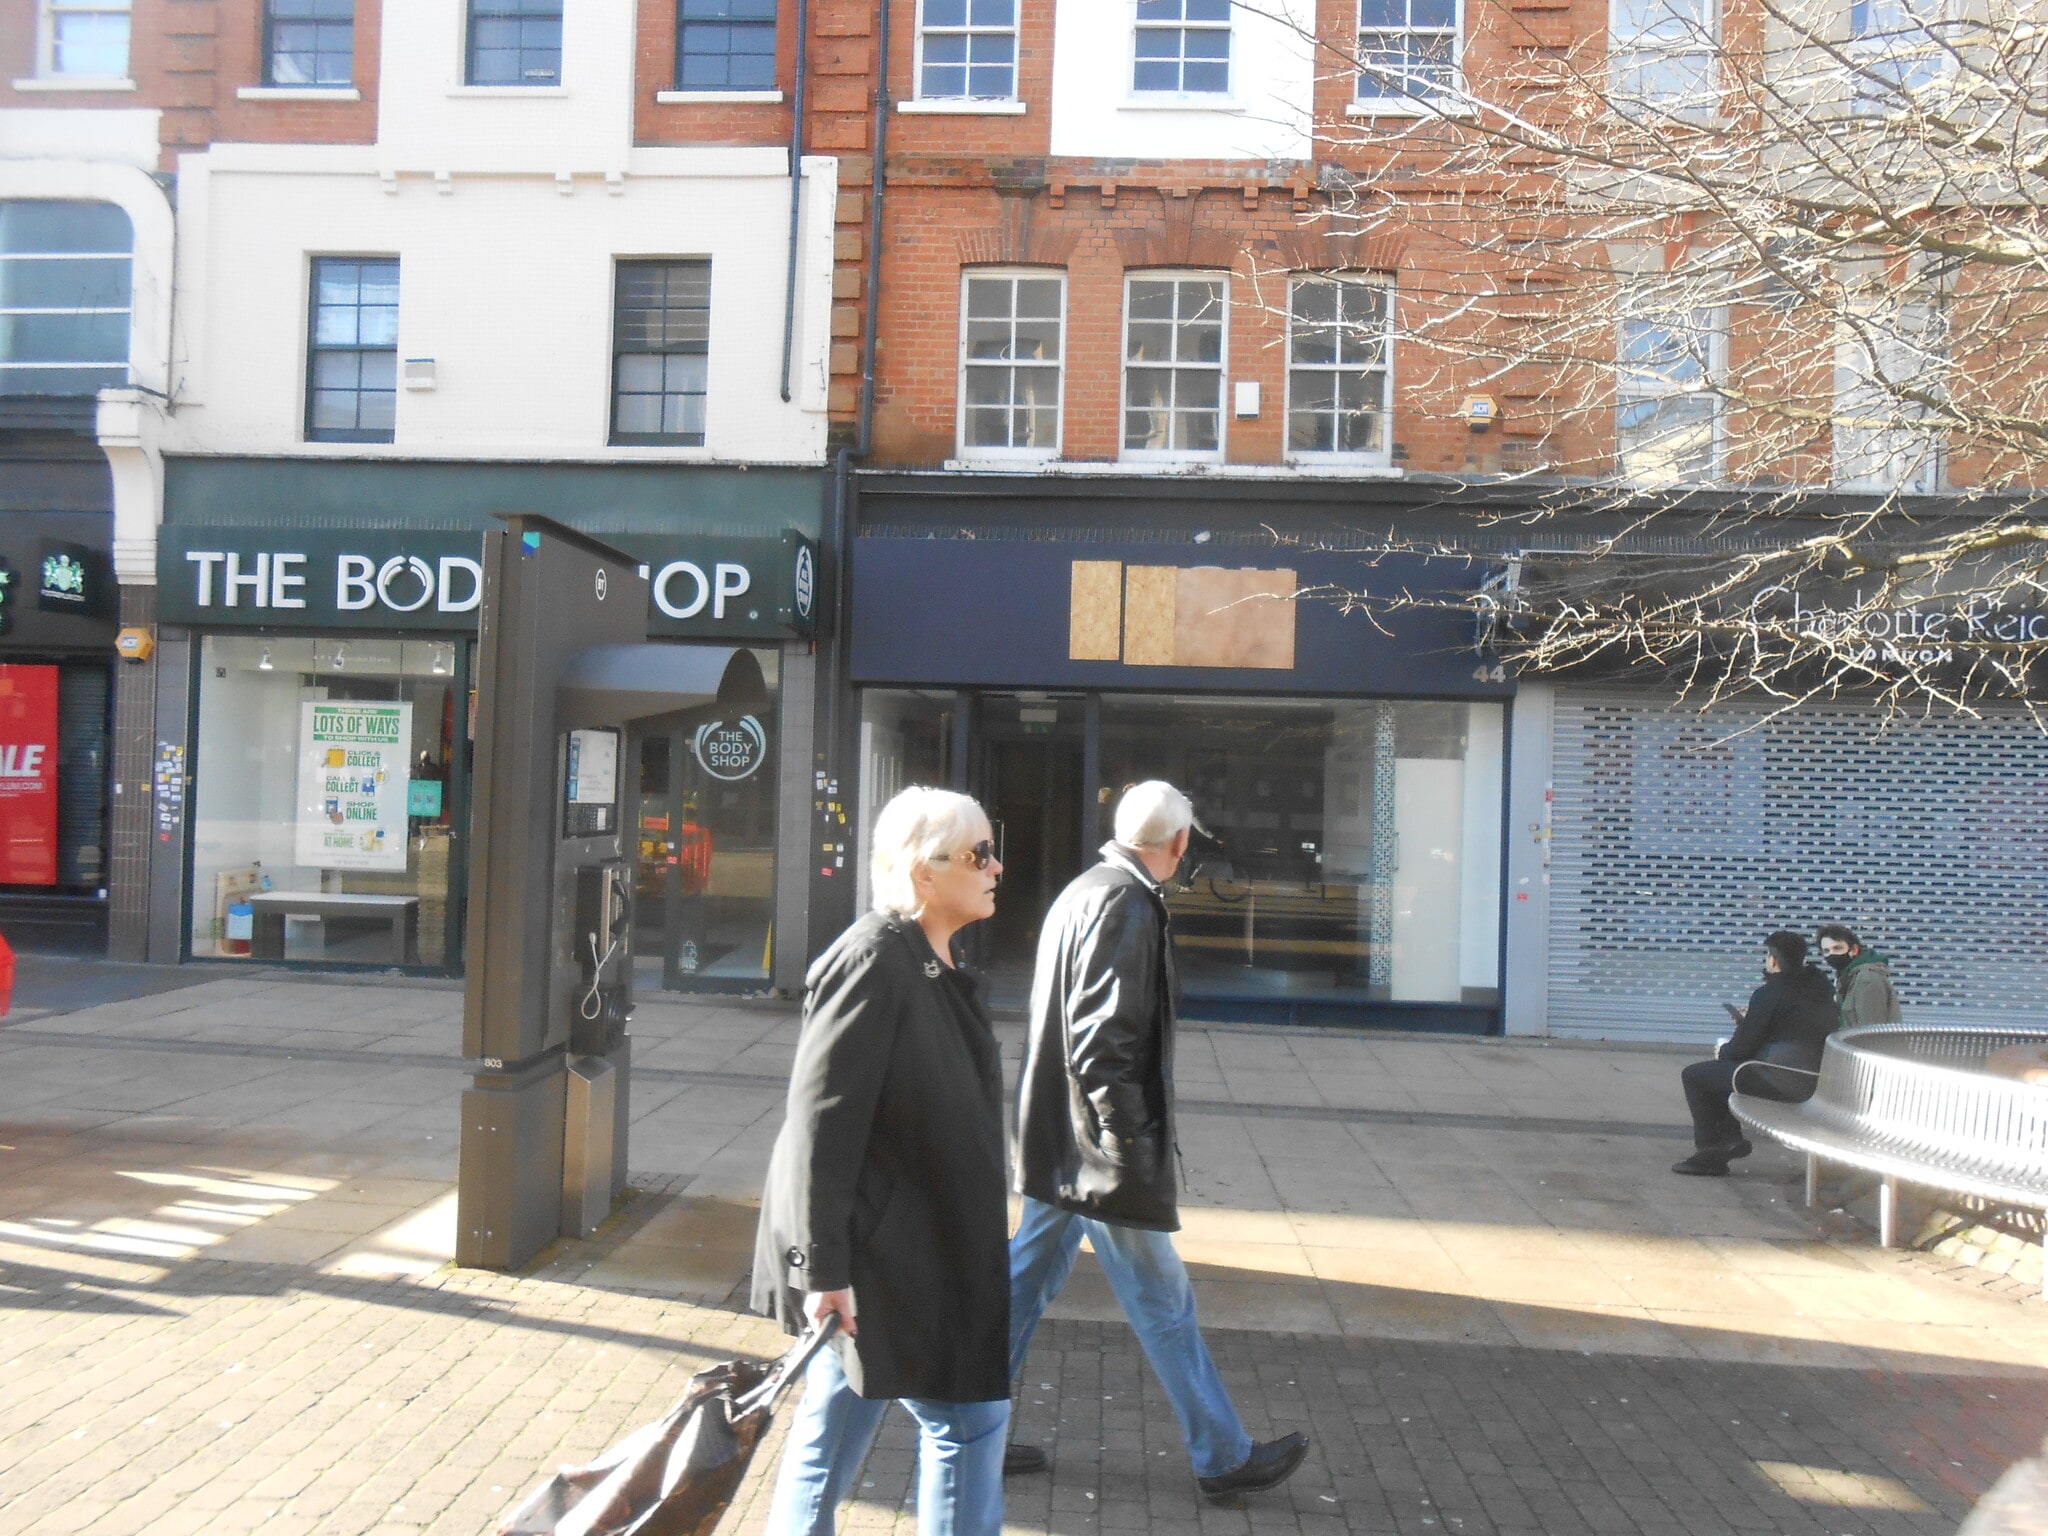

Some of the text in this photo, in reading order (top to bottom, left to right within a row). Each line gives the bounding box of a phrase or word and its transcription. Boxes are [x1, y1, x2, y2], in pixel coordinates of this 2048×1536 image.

[186, 551, 307, 608] THE
[337, 555, 483, 612] BOD
[639, 561, 750, 619] OP
[1751, 586, 1947, 639] Chalotte
[1473, 665, 1506, 682] 44
[313, 715, 400, 735] LOTS OF WAYS
[719, 731, 743, 741] THE
[709, 742, 752, 754] BODY
[347, 756, 381, 767] COLLECT
[711, 755, 750, 767] SHOP
[326, 781, 359, 793] COLLECT
[346, 807, 377, 821] ONLINE
[324, 837, 354, 848] AT HOME
[484, 1058, 502, 1069] 803
